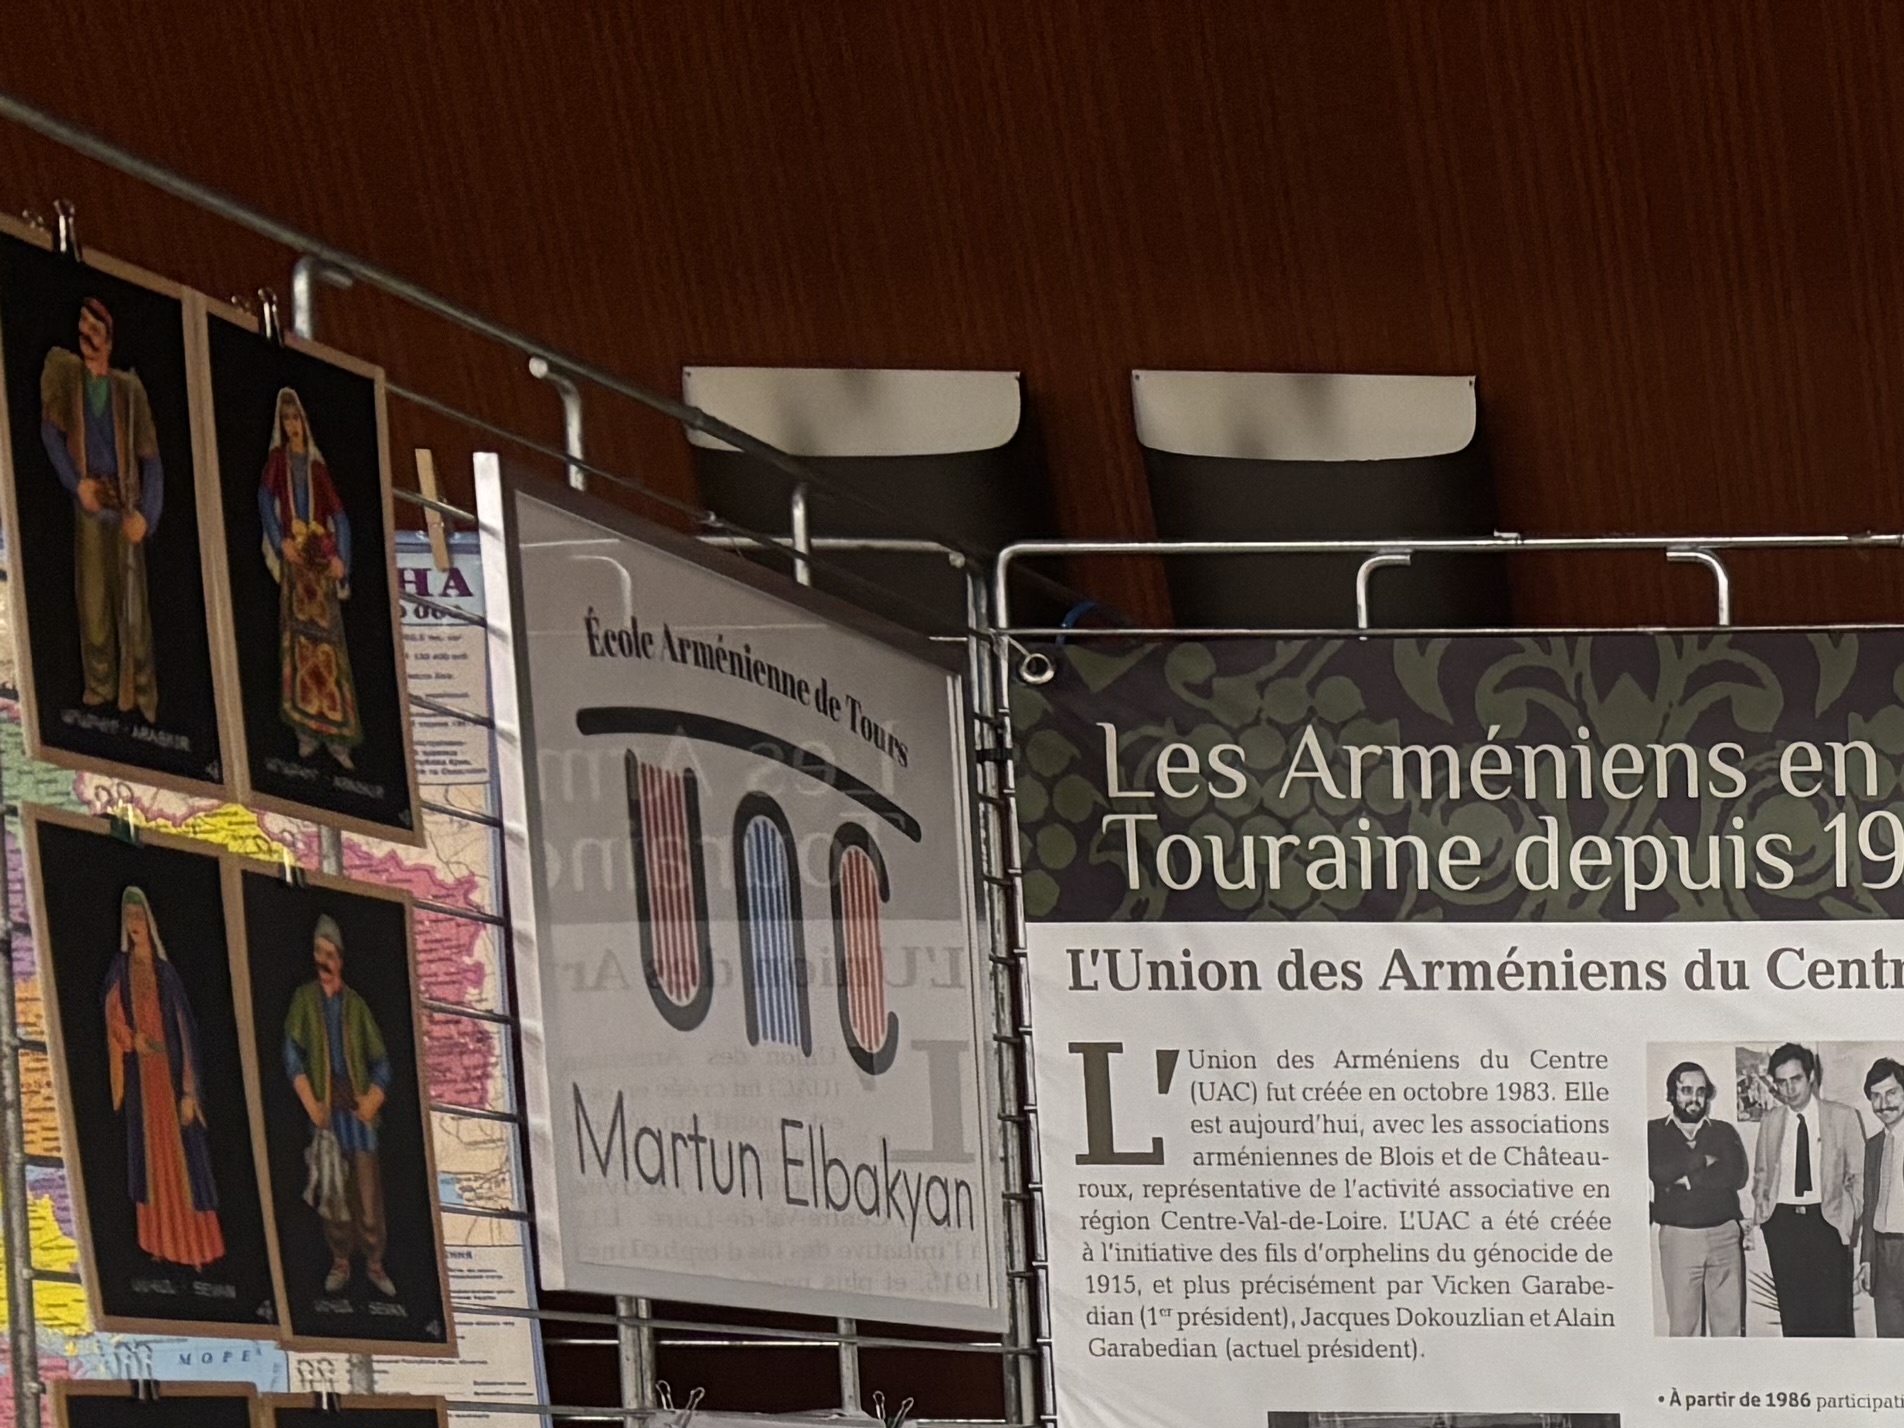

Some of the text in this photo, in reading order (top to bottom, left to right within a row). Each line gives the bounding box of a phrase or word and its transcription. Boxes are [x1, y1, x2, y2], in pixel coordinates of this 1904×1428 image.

[585, 605, 909, 768] École Arménienne de Tours
[1100, 722, 1879, 800] Les Arméniens en
[1102, 814, 1482, 891] Touraine
[1515, 816, 1793, 911] depuis
[1066, 947, 1261, 992] L'Union
[1278, 949, 1363, 992] des
[1379, 947, 1667, 992] Arméniens
[1685, 948, 1749, 992] du
[1188, 1048, 1608, 1070] Union des Arméniens du Centre
[573, 1081, 974, 1243] Martun Elbakyan
